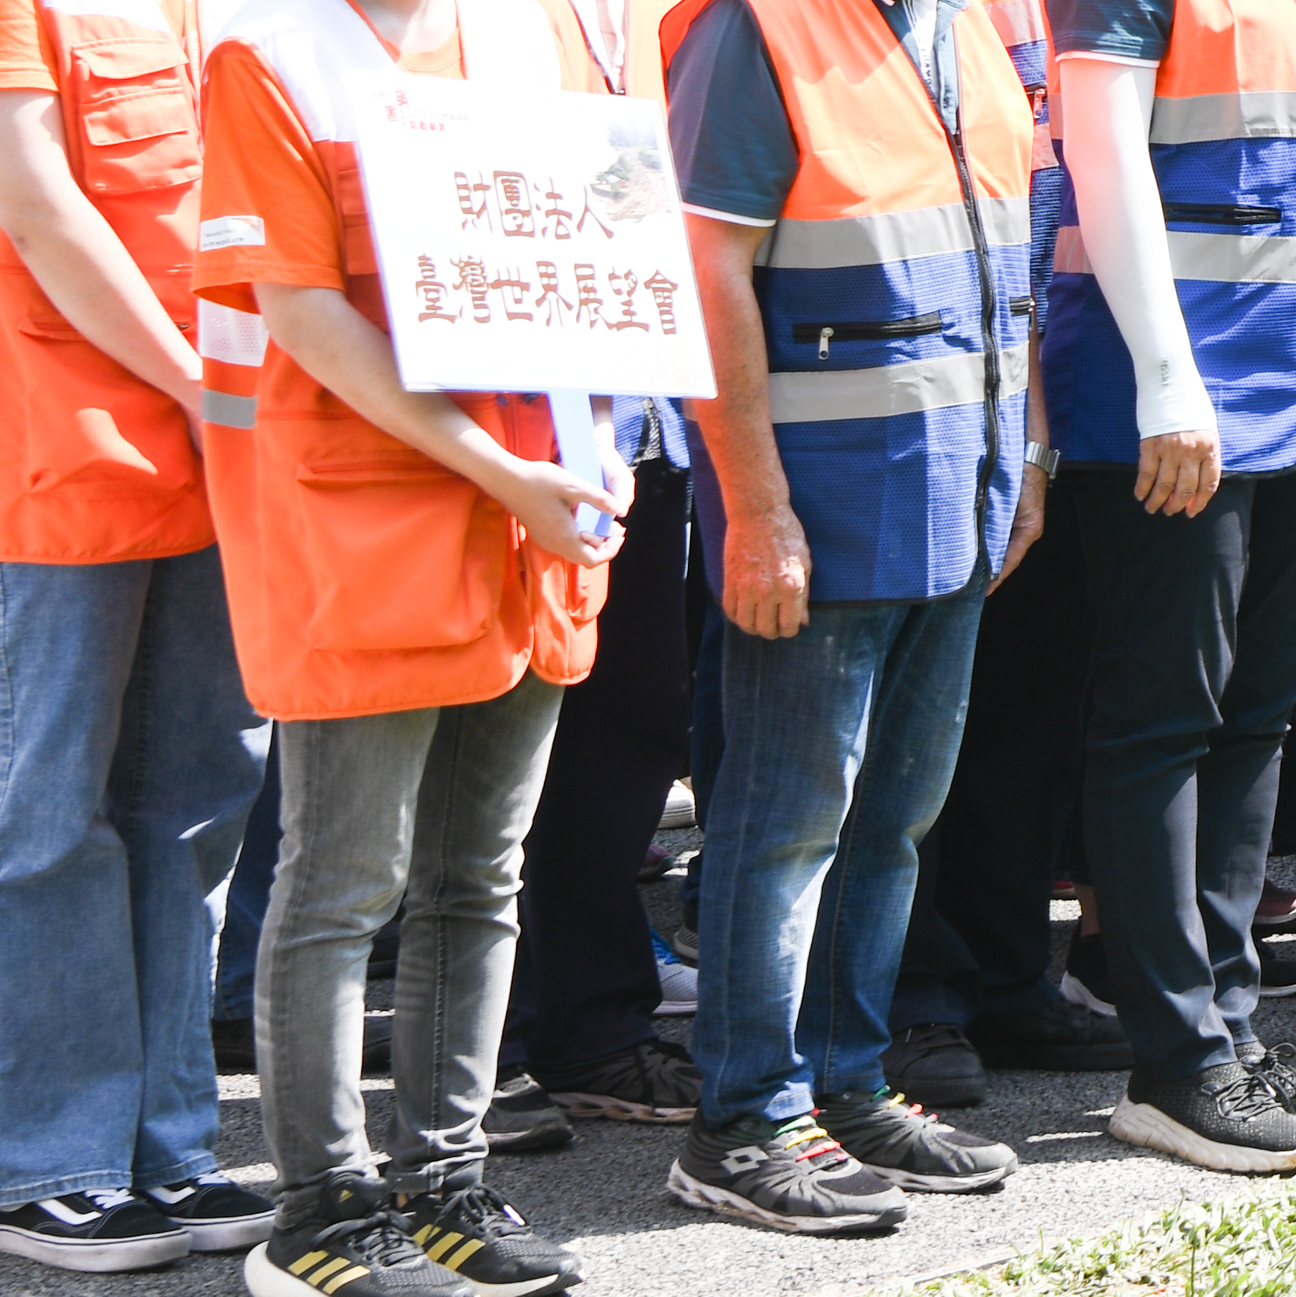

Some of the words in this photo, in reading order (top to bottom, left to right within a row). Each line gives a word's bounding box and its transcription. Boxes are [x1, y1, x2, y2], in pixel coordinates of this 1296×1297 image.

[454, 170, 615, 240] 財團法人
[415, 252, 679, 336] 臺灣世界展望會
